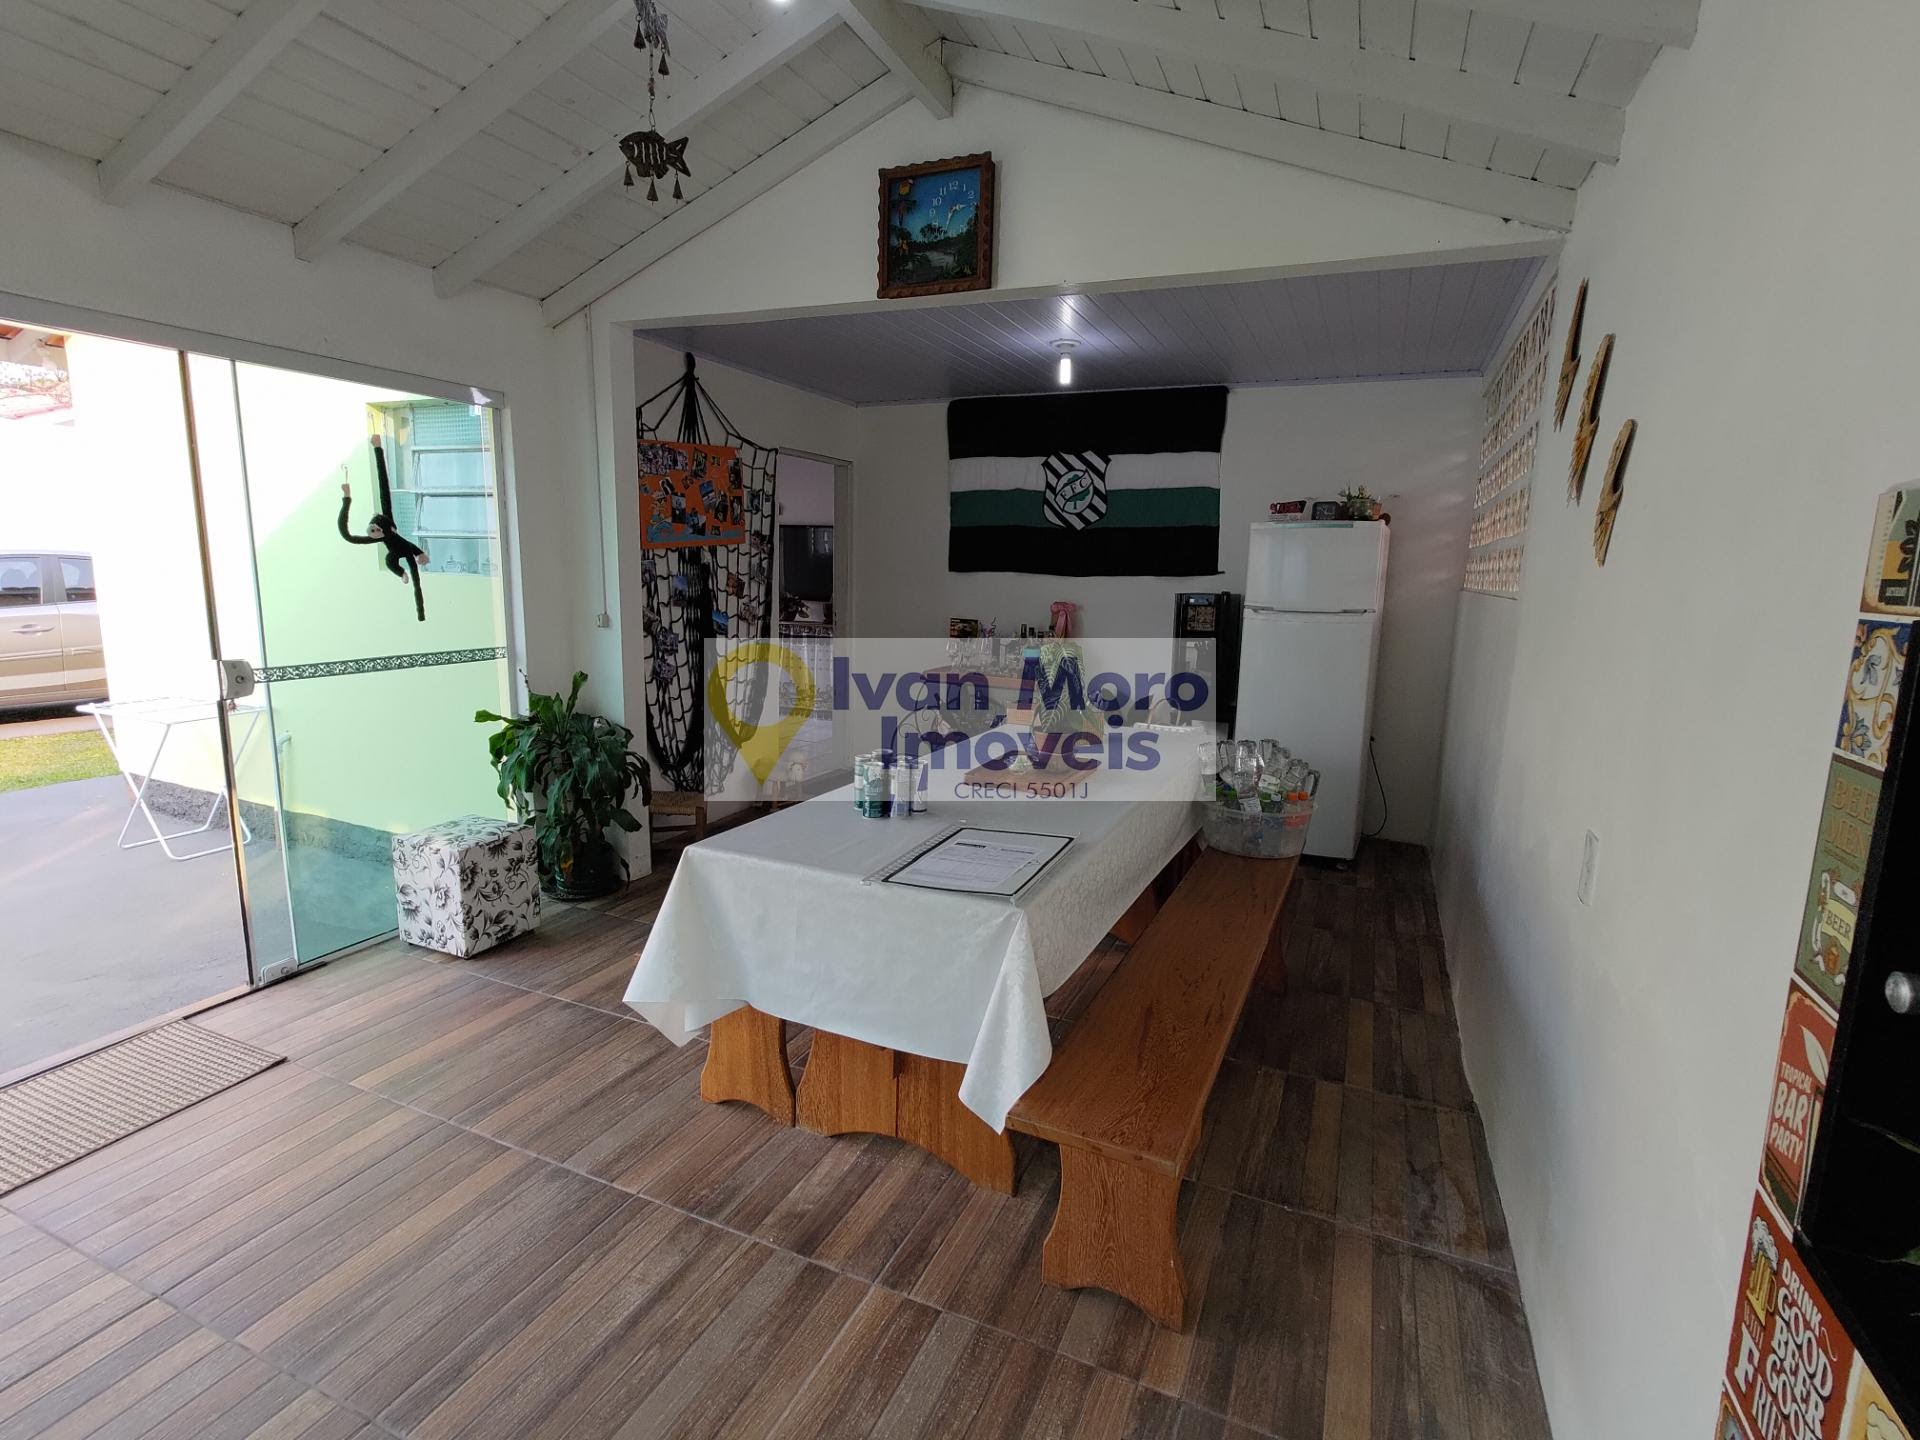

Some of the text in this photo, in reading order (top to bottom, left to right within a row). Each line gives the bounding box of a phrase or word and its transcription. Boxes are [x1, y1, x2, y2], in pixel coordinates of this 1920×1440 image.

[1831, 777, 1876, 826] BEE
[1825, 910, 1852, 940] BEER
[1780, 1061, 1812, 1094] TROPICAL
[1774, 1081, 1808, 1136] BAR
[1769, 1121, 1804, 1165] PARTY
[1782, 1258, 1822, 1338] DRINK
[1777, 1286, 1833, 1398] GOOD
[1766, 1353, 1818, 1440] GOO
[1771, 1315, 1825, 1440] BEER
